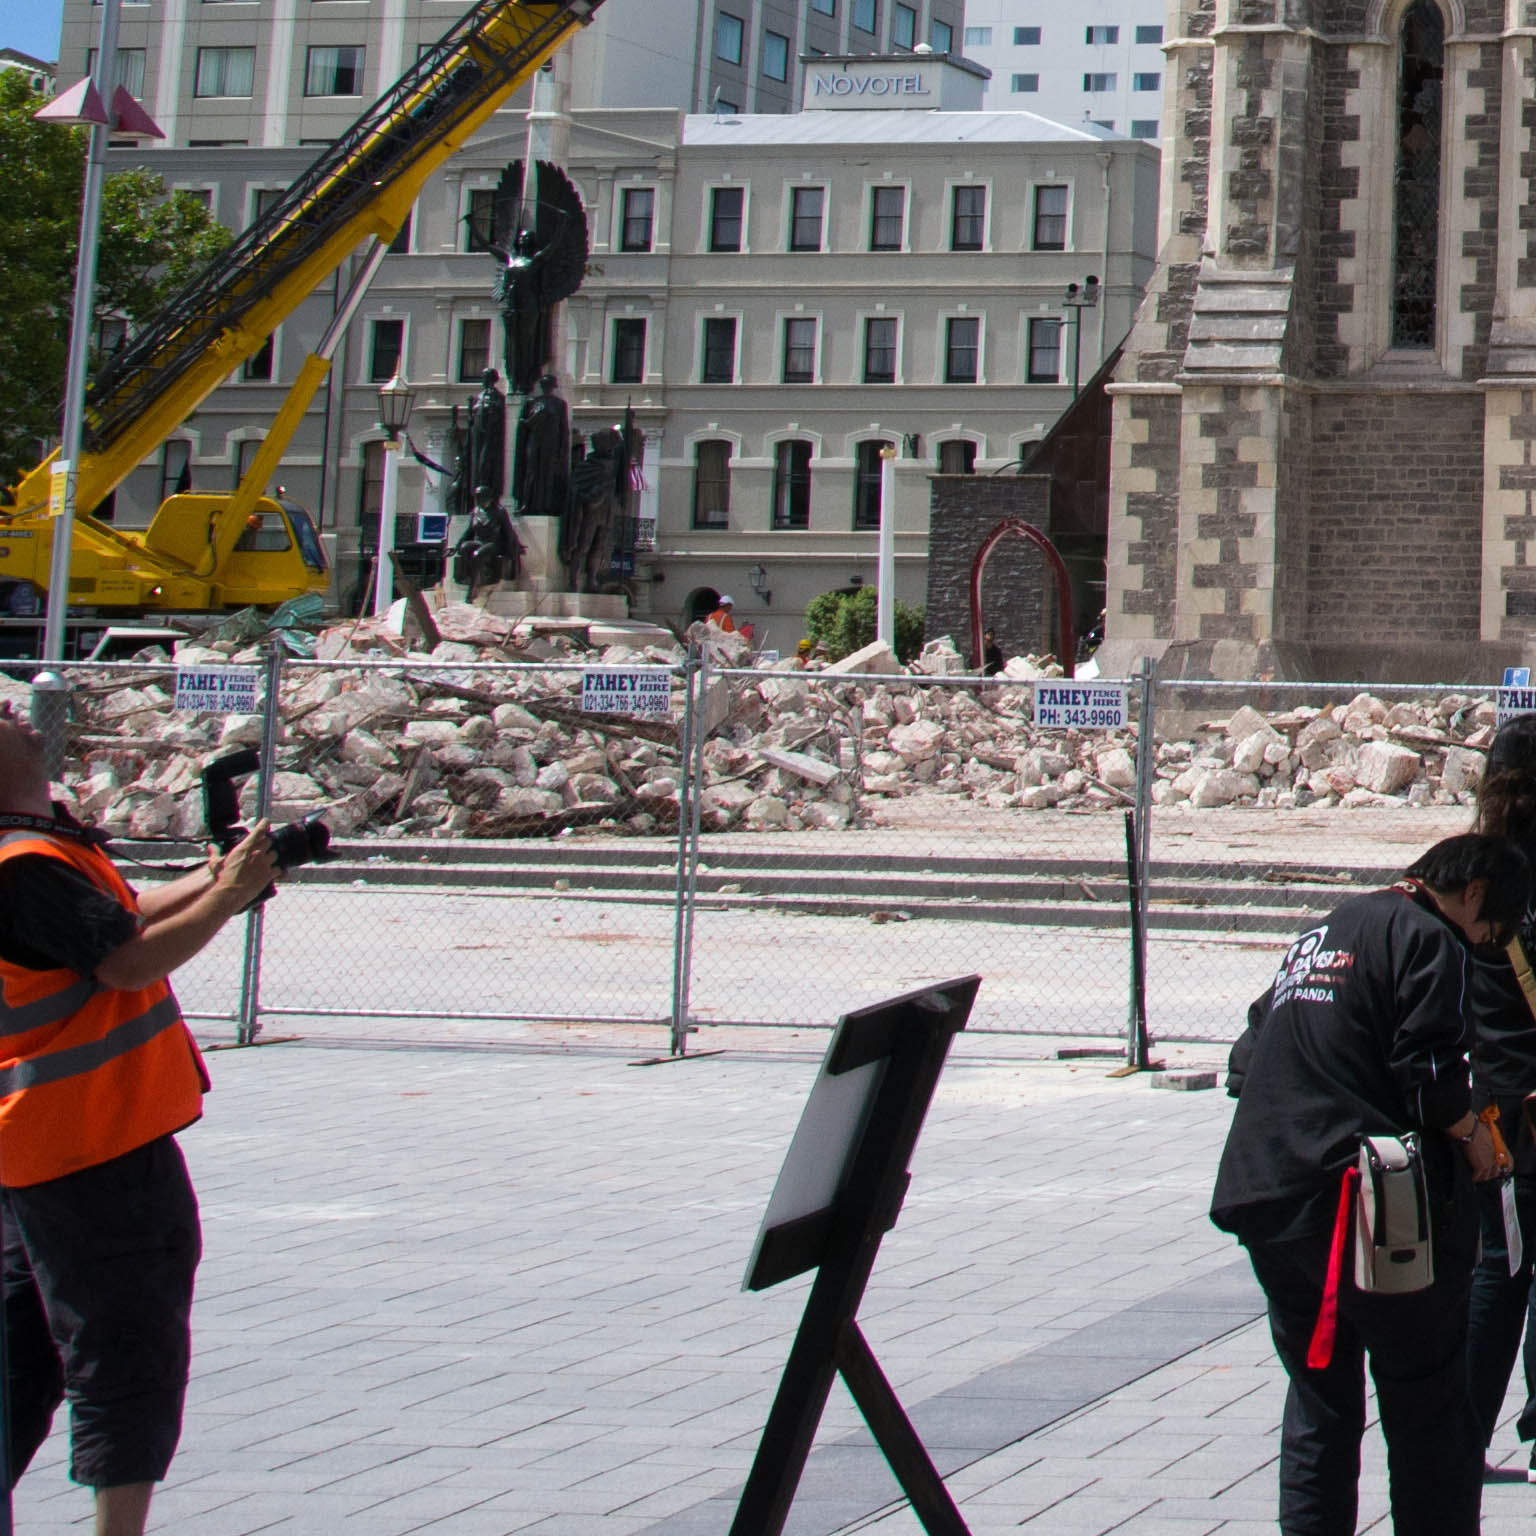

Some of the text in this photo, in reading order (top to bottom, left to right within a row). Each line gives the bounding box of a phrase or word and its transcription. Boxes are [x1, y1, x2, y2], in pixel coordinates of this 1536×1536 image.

[814, 71, 931, 96] NOVOTEL
[179, 673, 228, 691] FAHEY
[585, 674, 638, 691] FAHEY
[1039, 689, 1091, 705] FAHEY
[1040, 709, 1121, 726] PH: 343-9960
[1294, 987, 1334, 1003] PANDA
